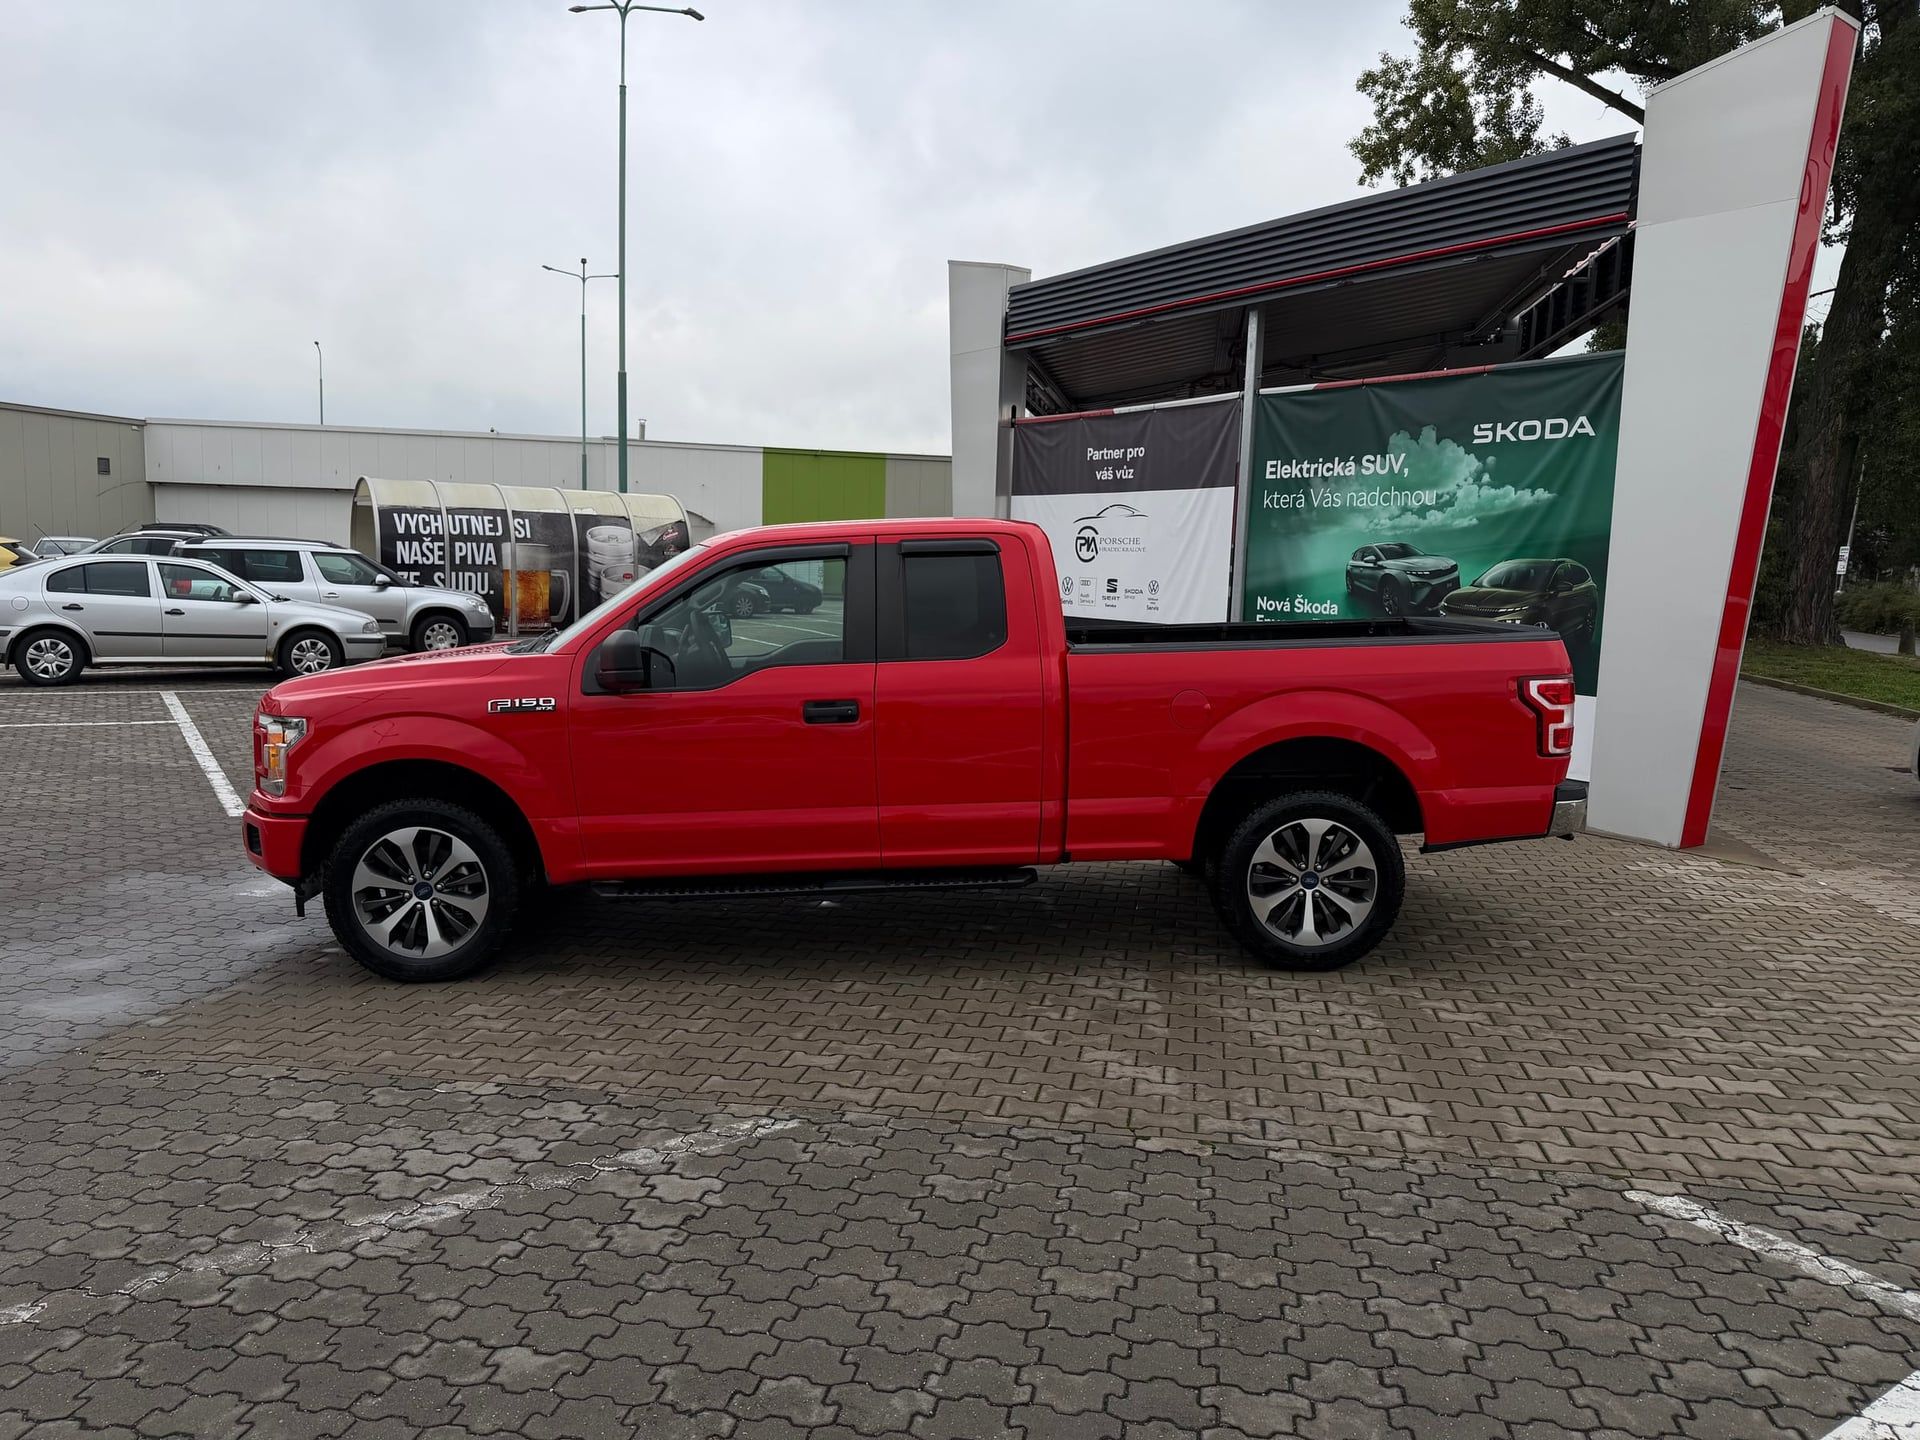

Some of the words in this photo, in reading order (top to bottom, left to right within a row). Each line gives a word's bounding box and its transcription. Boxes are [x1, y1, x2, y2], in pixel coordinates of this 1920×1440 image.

[1087, 447, 1125, 461] Partner
[1127, 446, 1145, 461] pro
[1095, 466, 1114, 481] váš
[1115, 465, 1134, 479] vůz
[1265, 456, 1356, 480] Elektrická
[1361, 453, 1409, 477] SUV,
[1263, 489, 1305, 509] která
[1311, 487, 1342, 508] Vás
[1346, 486, 1437, 507] nadchnou
[513, 518, 531, 538] SI
[396, 537, 445, 565] NAŠE
[455, 542, 497, 565] PIVA
[1099, 537, 1141, 545] PORSCHE
[1256, 596, 1291, 612] Nová
[1294, 594, 1338, 615] Škoda
